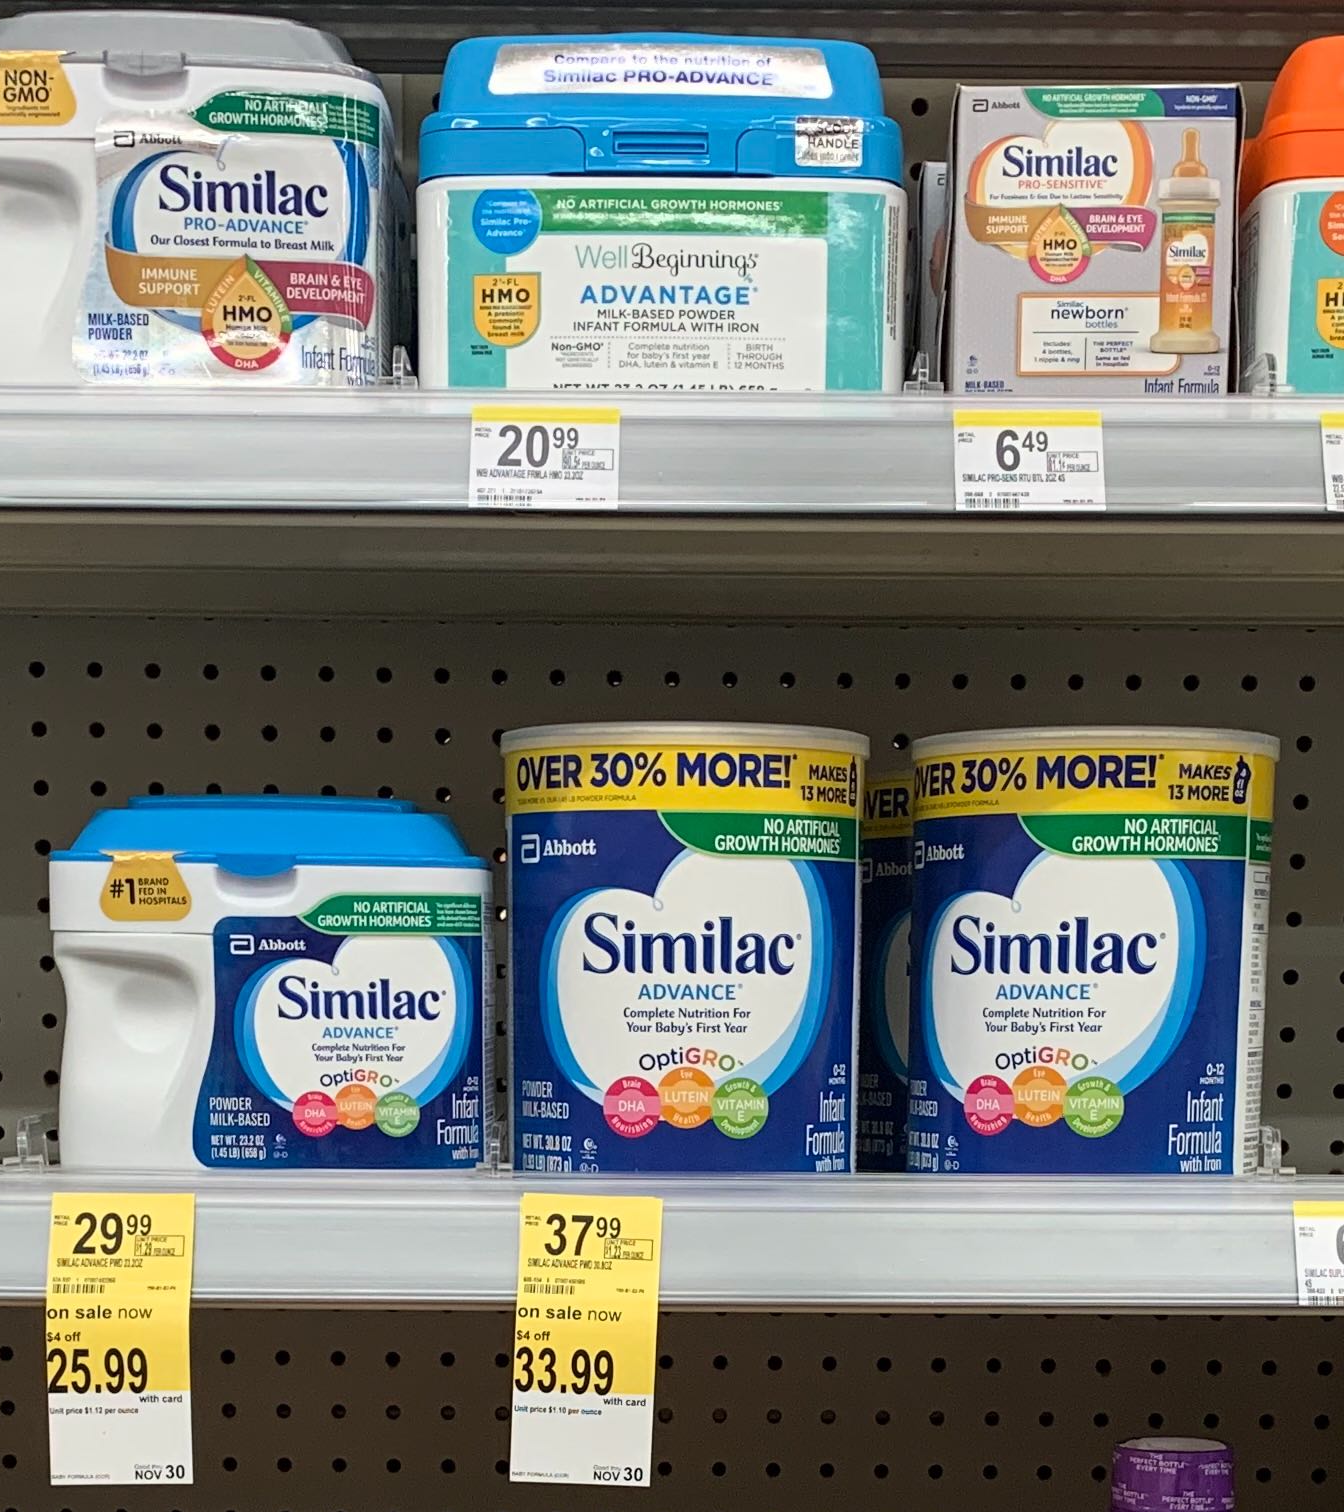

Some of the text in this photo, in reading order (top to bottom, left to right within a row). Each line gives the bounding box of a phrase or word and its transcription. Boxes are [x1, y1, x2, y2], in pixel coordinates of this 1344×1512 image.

[543, 70, 773, 86] Similac PRO-ADVANCE
[1003, 146, 1117, 181] Similac
[159, 164, 328, 217] Similac
[557, 199, 575, 210] NO
[579, 199, 647, 210] ARTIFICIAL
[651, 200, 706, 211] GROWTH
[576, 243, 758, 277] Well Beginnings
[580, 286, 750, 305] ADVANTAGE
[88, 314, 149, 327] MILK-BASED
[573, 323, 759, 332] INFANT FORMULA WITH IRON
[88, 327, 132, 340] POWDER
[960, 757, 1027, 793] 30%
[1179, 764, 1232, 780] MAKES
[1168, 785, 1230, 801] 13 MORE
[138, 878, 168, 886] BRAND
[110, 879, 166, 905] #1 FED IN
[139, 897, 187, 905] HOSPITALS
[951, 916, 1158, 976] Similac
[277, 977, 441, 1022] Similac
[46, 1305, 153, 1321] on sale now
[47, 1331, 81, 1343] $4 off
[48, 1347, 148, 1395] 25.99
[515, 1347, 614, 1396] 33.99
[162, 1395, 182, 1403] card
[135, 1465, 185, 1481] NOV 30
